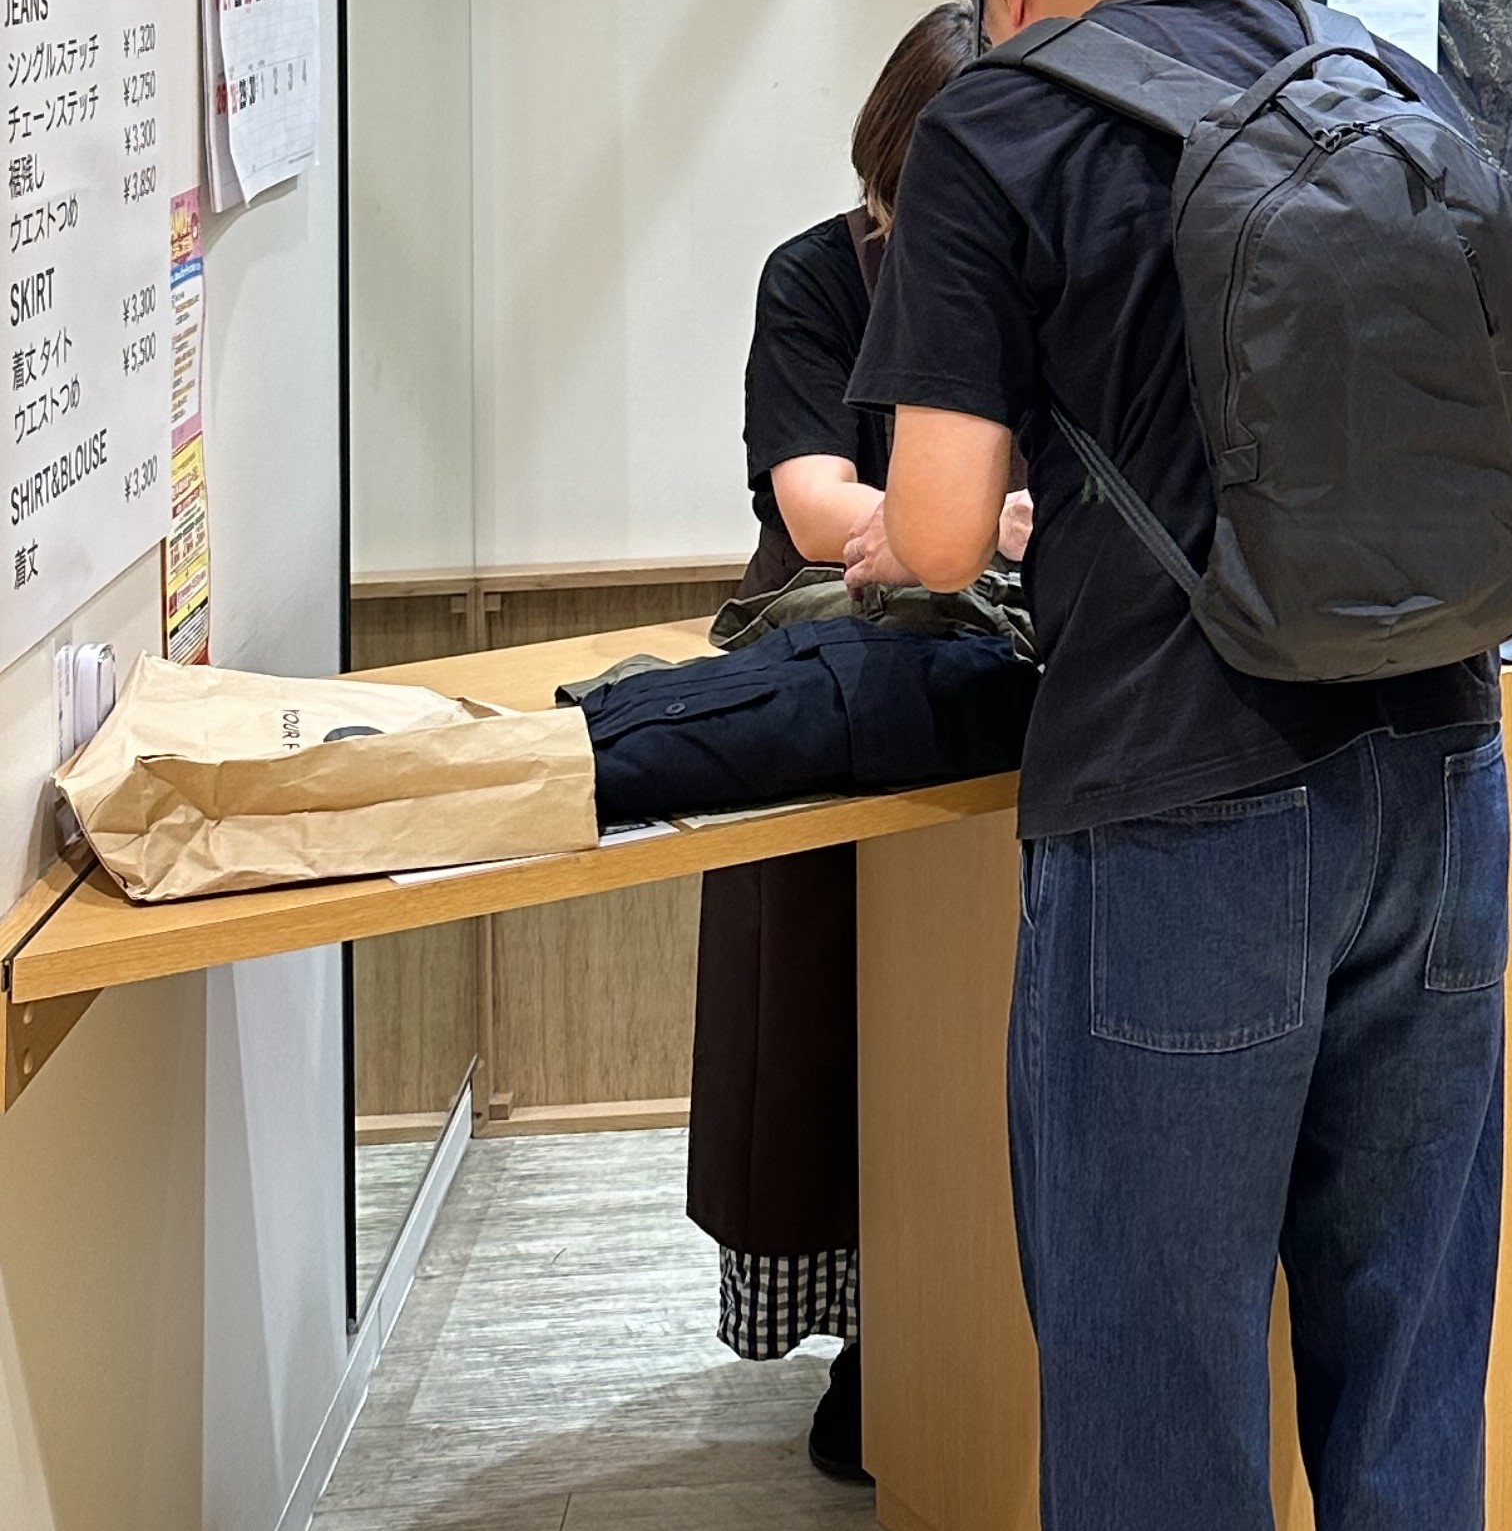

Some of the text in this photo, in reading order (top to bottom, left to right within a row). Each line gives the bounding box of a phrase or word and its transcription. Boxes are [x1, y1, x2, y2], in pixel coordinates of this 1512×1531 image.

[8, 34, 99, 88] シングルステッチ
[8, 84, 99, 143] チェーンステッチ
[124, 118, 156, 155] ¥3,300
[10, 193, 78, 253] ウエストつめ
[10, 267, 54, 327] SKIRT
[123, 284, 156, 328] ¥3,300
[14, 373, 81, 444] ウエストつめ
[123, 331, 156, 376] ¥5,500
[11, 428, 108, 526] SHIRT&BLOUSE
[124, 454, 158, 503] ¥3,300
[282, 709, 300, 739] YOUR
